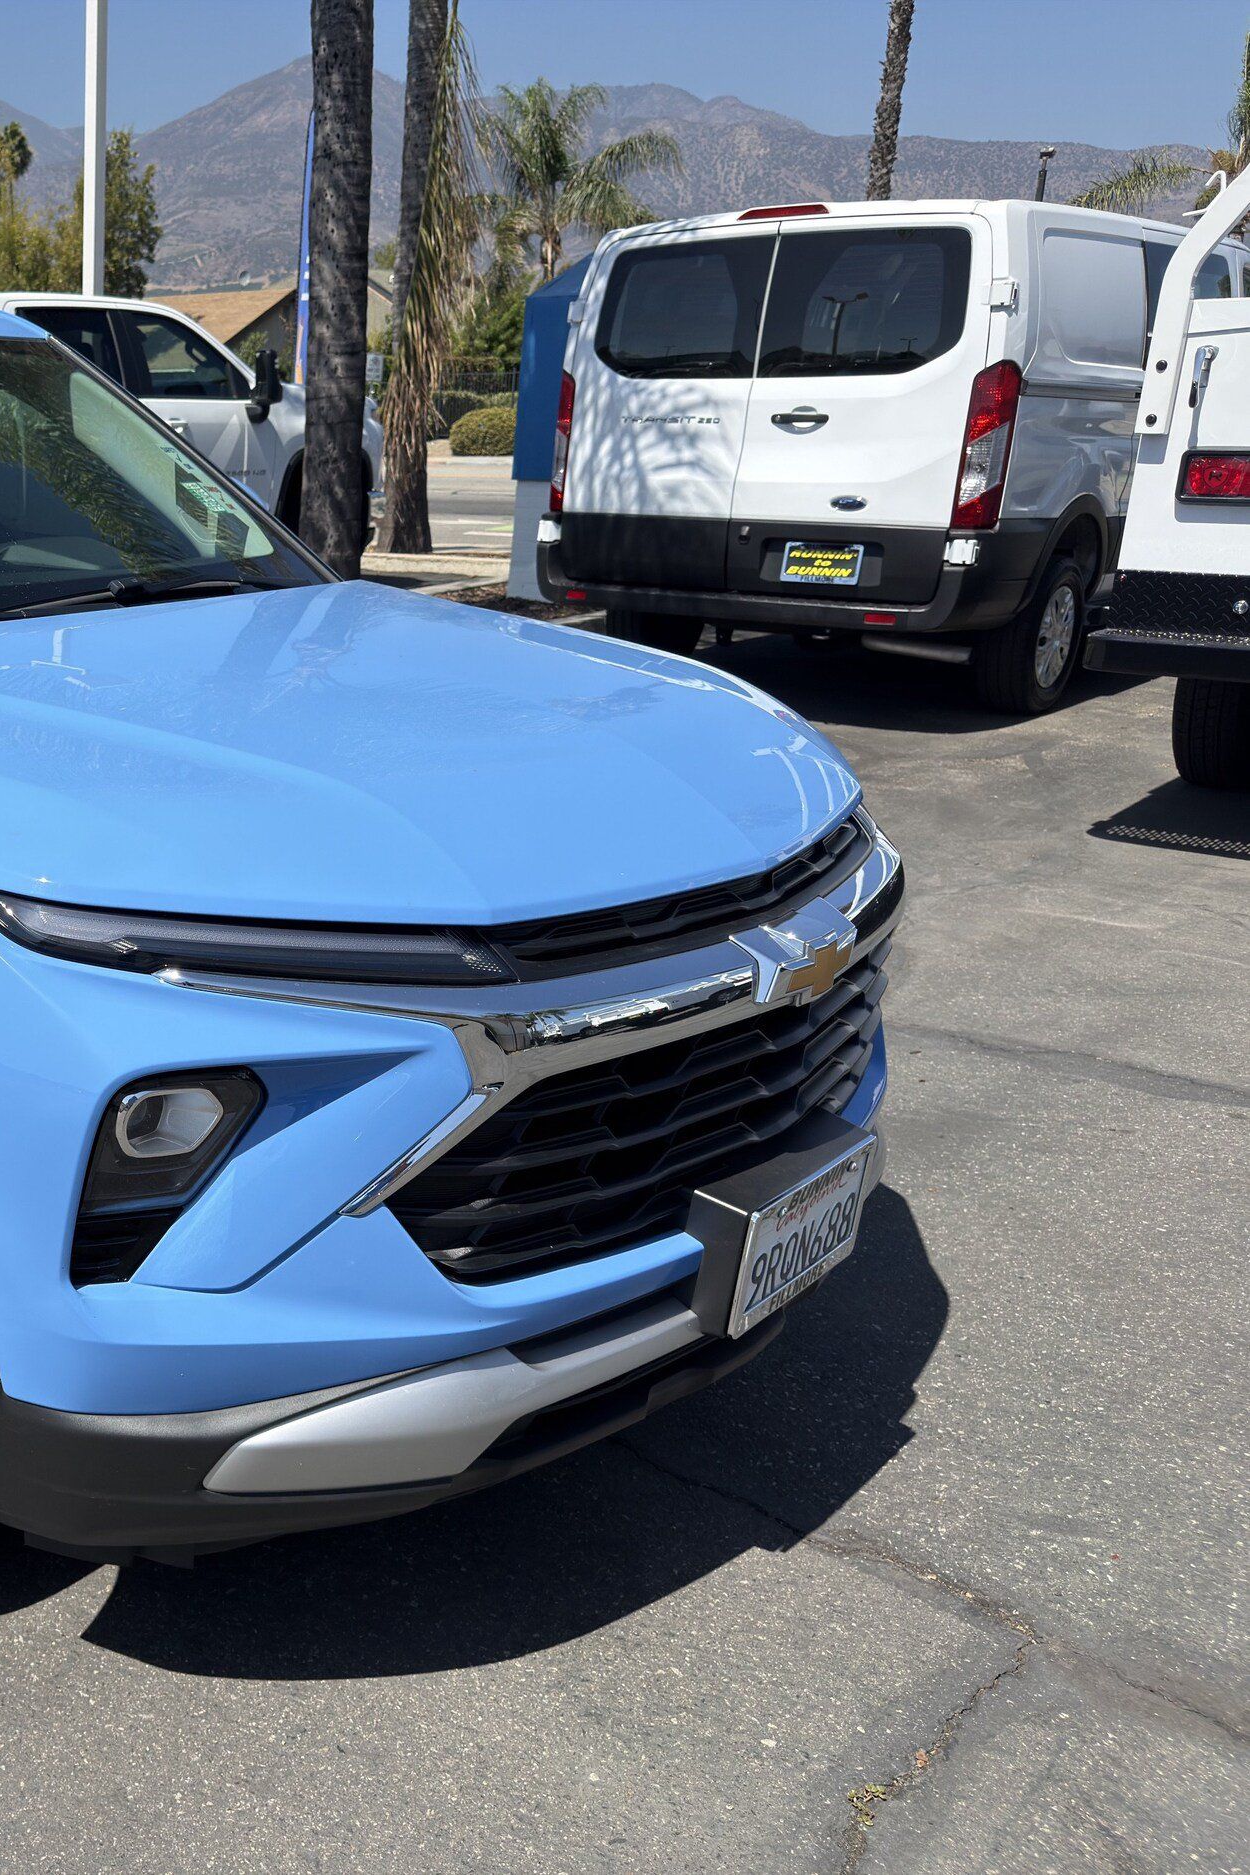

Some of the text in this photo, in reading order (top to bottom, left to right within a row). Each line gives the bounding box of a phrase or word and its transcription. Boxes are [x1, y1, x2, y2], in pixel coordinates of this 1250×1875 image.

[621, 416, 696, 425] TRANSIT
[813, 559, 832, 567] to
[785, 565, 852, 577] BUNNIN
[743, 1191, 856, 1313] 9RQN688
[768, 1259, 827, 1313] FILLMORE
